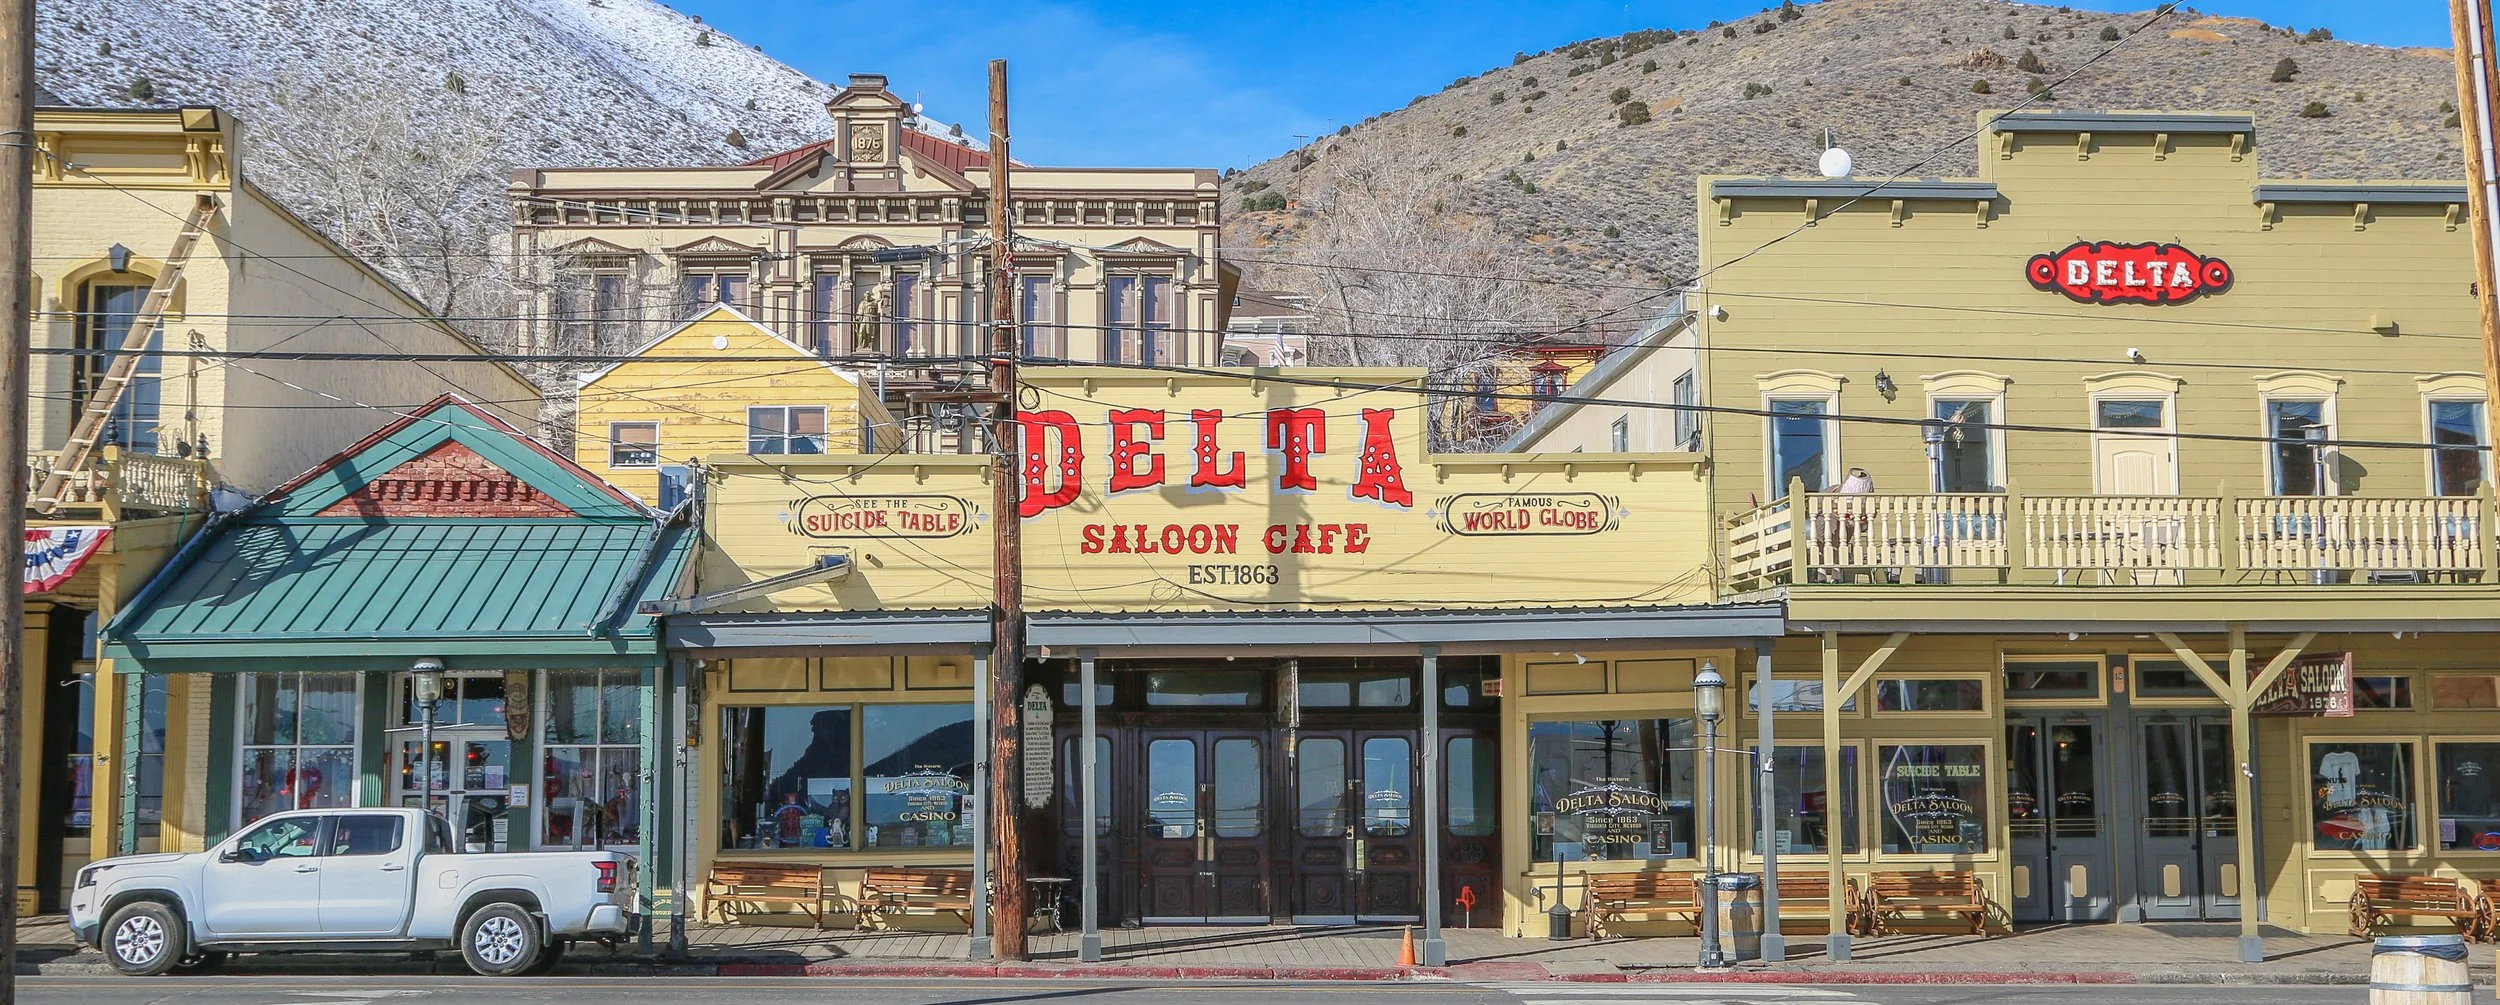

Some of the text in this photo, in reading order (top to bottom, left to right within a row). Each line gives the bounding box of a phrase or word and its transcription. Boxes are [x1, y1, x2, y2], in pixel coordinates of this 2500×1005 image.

[854, 137, 881, 149] 1876
[2067, 259, 2193, 288] DELTA
[1016, 408, 1413, 518] DELTA
[856, 499, 908, 509] SEE THE
[1508, 498, 1552, 508] FAMOUS
[806, 510, 960, 532] SUICIDE TABLE
[1463, 508, 1598, 531] WORLD GLOBE
[1081, 523, 1372, 554] SALOON CAFE
[1188, 564, 1280, 585] EST.1863
[2301, 664, 2345, 693] SALOON
[1027, 702, 1047, 710] DELTA
[2310, 696, 2336, 710] 1876
[1896, 764, 1980, 777] SUICIDE TABLE
[884, 776, 969, 792] DELTA SALOON
[1556, 792, 1668, 812] DELTA SALOON
[1892, 800, 1973, 814] DELTA SALOON
[2360, 796, 2405, 810] SALOON
[900, 812, 956, 822] CASINO
[1587, 834, 1642, 844] CASINO
[1910, 835, 1963, 844] CASINO
